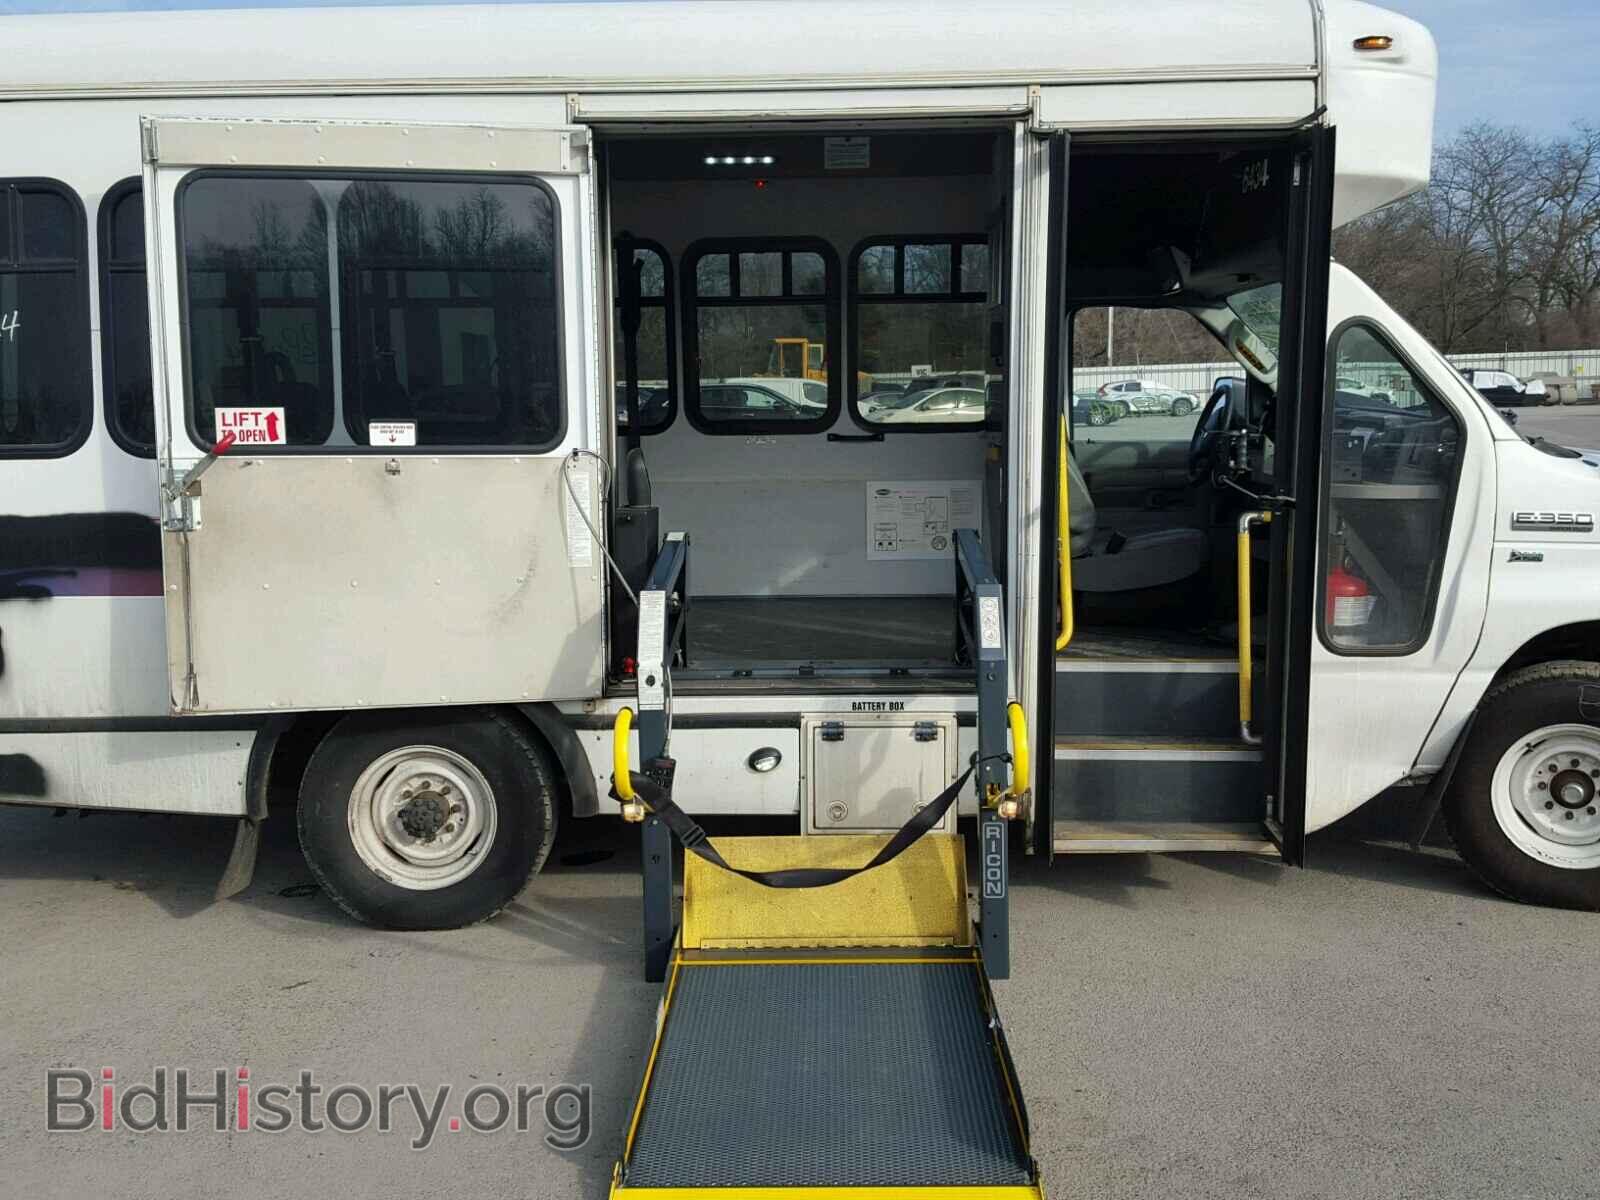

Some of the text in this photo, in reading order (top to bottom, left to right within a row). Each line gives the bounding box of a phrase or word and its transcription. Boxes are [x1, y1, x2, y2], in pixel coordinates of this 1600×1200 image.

[221, 412, 262, 427] LIFT
[239, 429, 266, 442] OPEN
[852, 701, 905, 711] BATTERY BOX
[985, 826, 1001, 894] RICON
